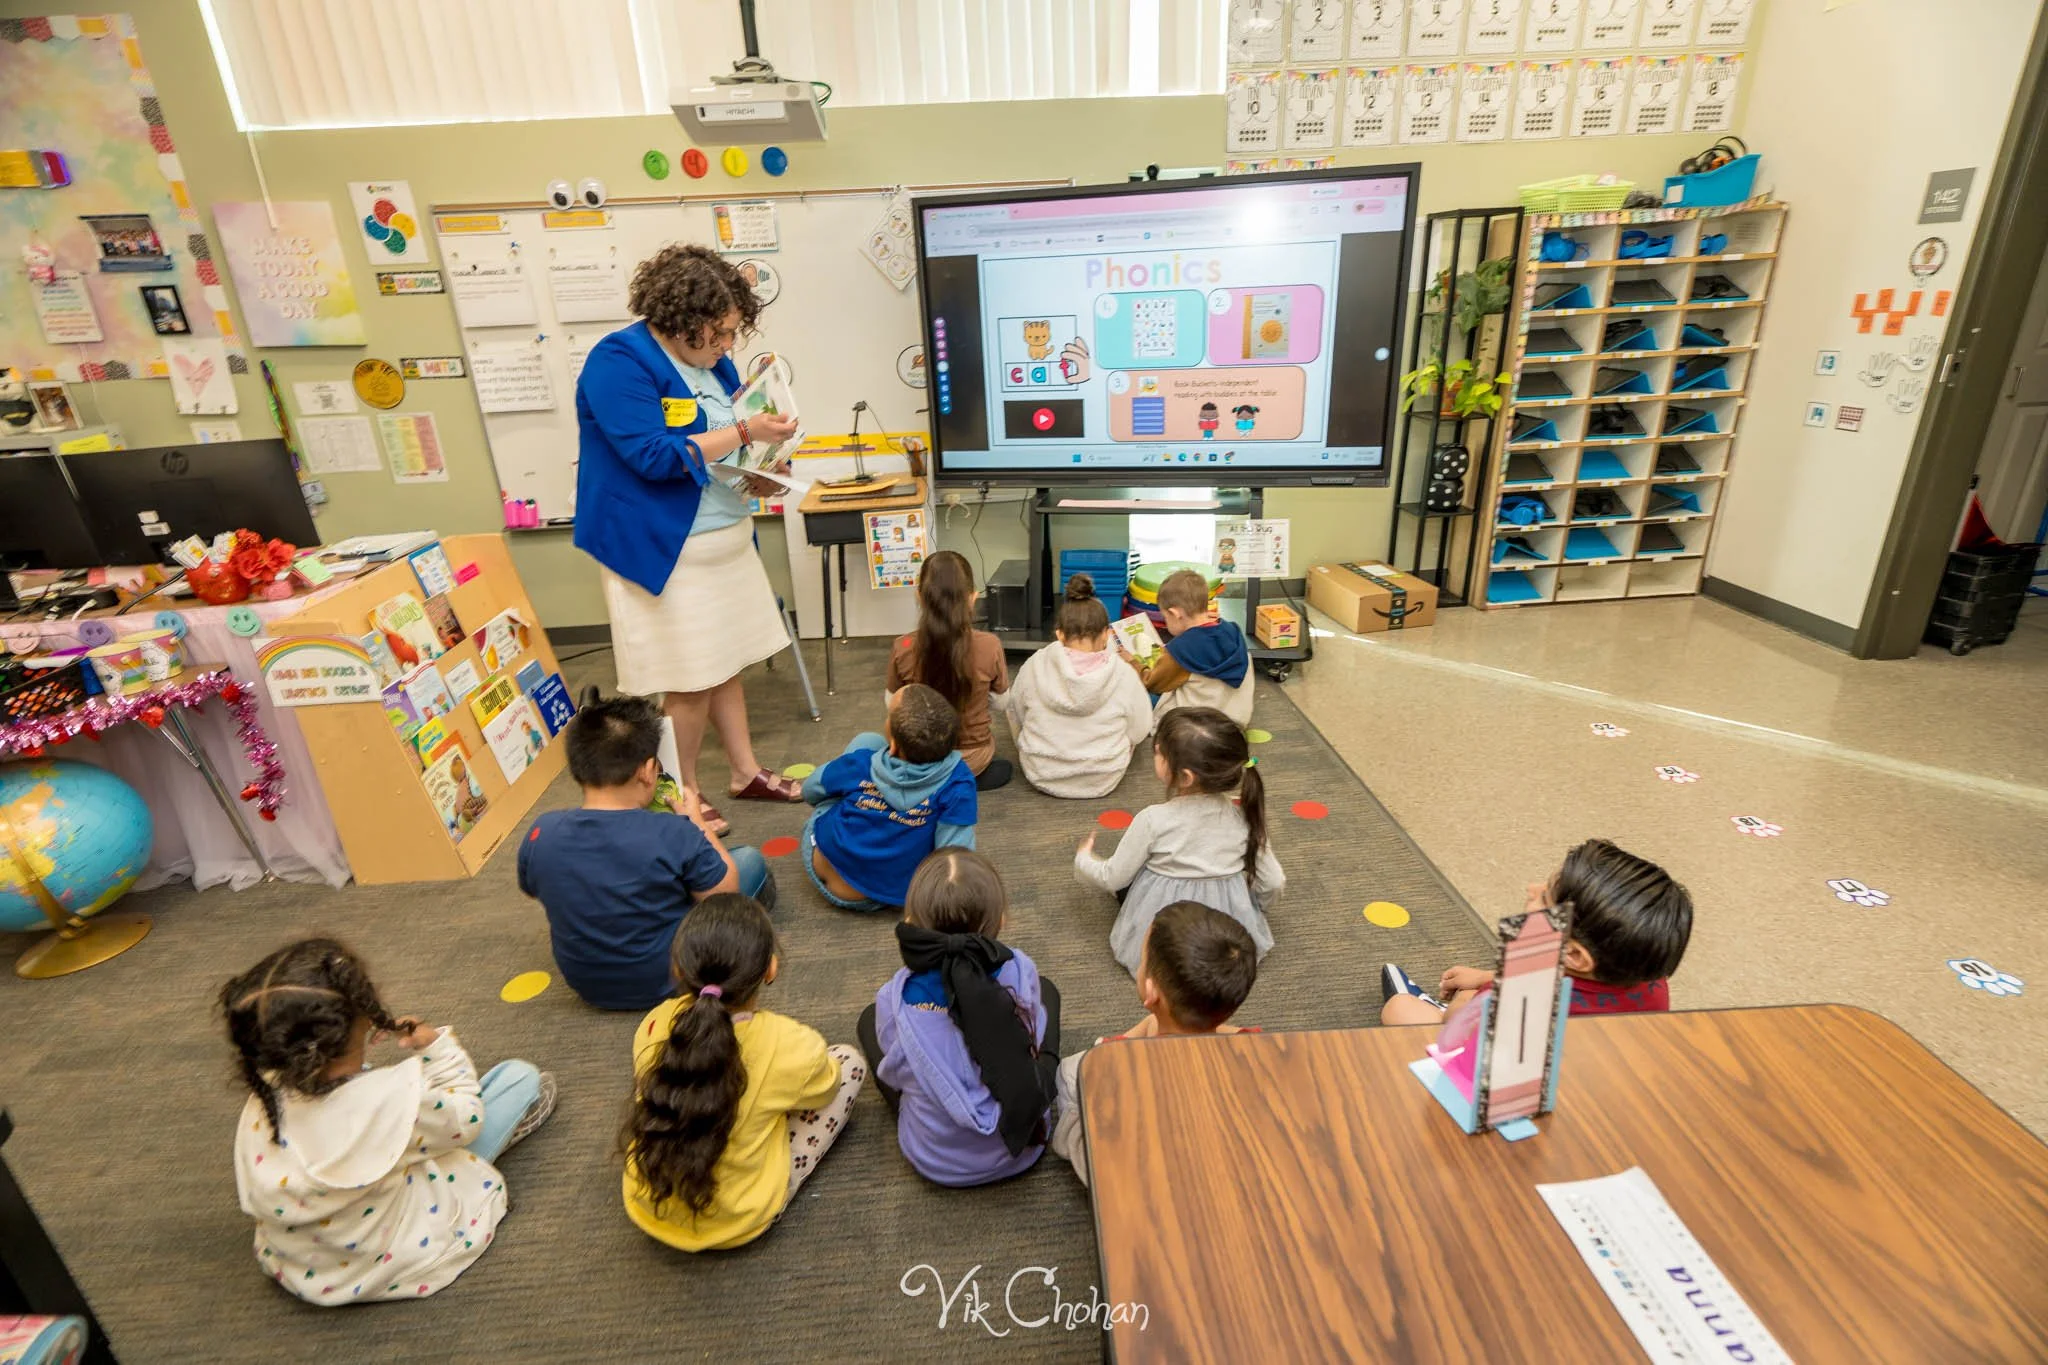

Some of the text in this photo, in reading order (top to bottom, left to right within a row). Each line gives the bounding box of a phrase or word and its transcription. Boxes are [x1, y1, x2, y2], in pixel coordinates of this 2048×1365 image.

[1315, 7, 1323, 23] 2
[1374, 5, 1382, 21] 3
[1594, 86, 1606, 100] 16
[1651, 83, 1662, 98] 17
[1707, 81, 1718, 96] 18
[1364, 95, 1376, 109] 12
[1421, 93, 1432, 107] 13
[1479, 93, 1490, 104] 14
[1536, 89, 1547, 103] 15
[1248, 101, 1260, 115] 10
[254, 238, 313, 256] MAKE
[253, 258, 319, 278] TODAY
[1086, 253, 1222, 289] Phonics
[258, 281, 329, 299] A GOOD
[281, 301, 318, 319] DAY
[1174, 380, 1189, 388] Book
[1174, 391, 1198, 401] reading
[1594, 723, 1616, 731] 20
[1663, 766, 1681, 776] 19
[1738, 816, 1761, 827] 18
[1836, 881, 1863, 893] 17
[1959, 961, 1991, 978] 16
